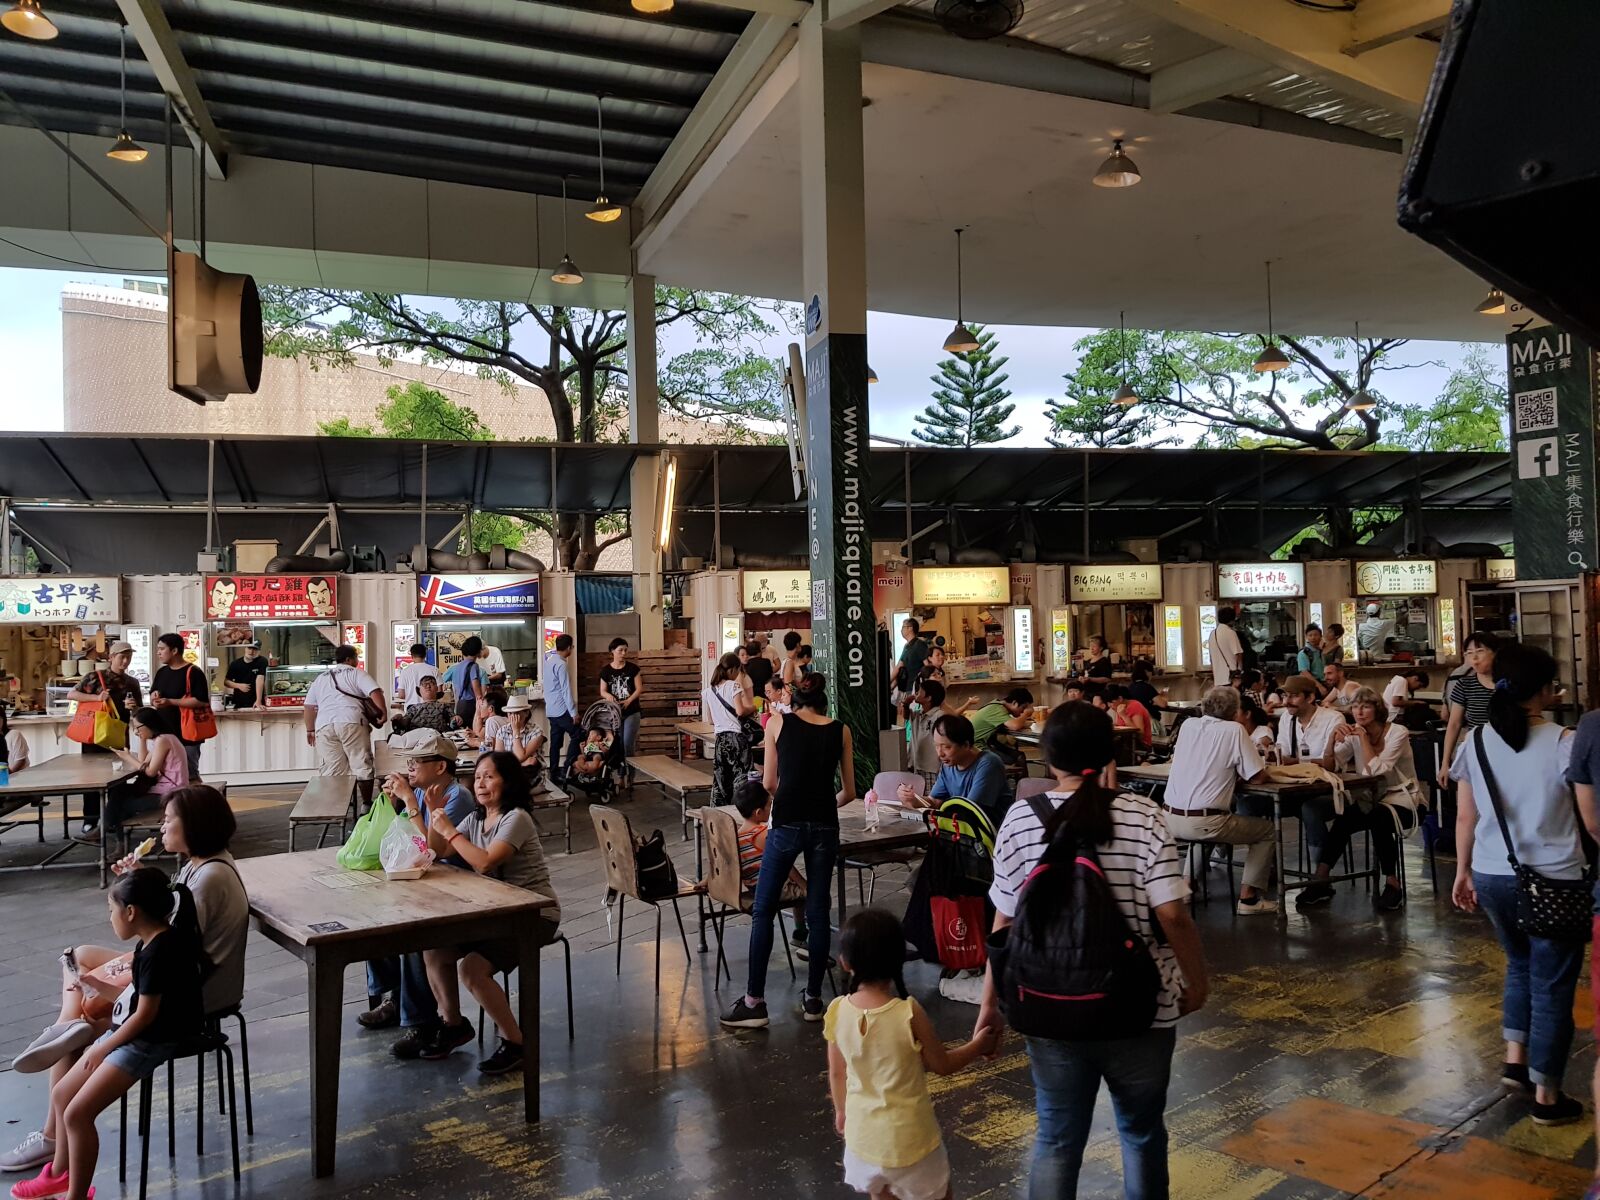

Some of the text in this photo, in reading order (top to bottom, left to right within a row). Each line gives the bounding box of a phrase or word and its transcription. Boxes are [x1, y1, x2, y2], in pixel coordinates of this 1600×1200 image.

[1512, 333, 1572, 365] MAJI
[840, 405, 865, 687] www.majisquare.com
[878, 576, 903, 587] meiji
[1073, 574, 1112, 587] BIG BANG
[32, 583, 104, 604] 古早味
[34, 608, 71, 617] ドウホア
[444, 655, 465, 665] SHUC
